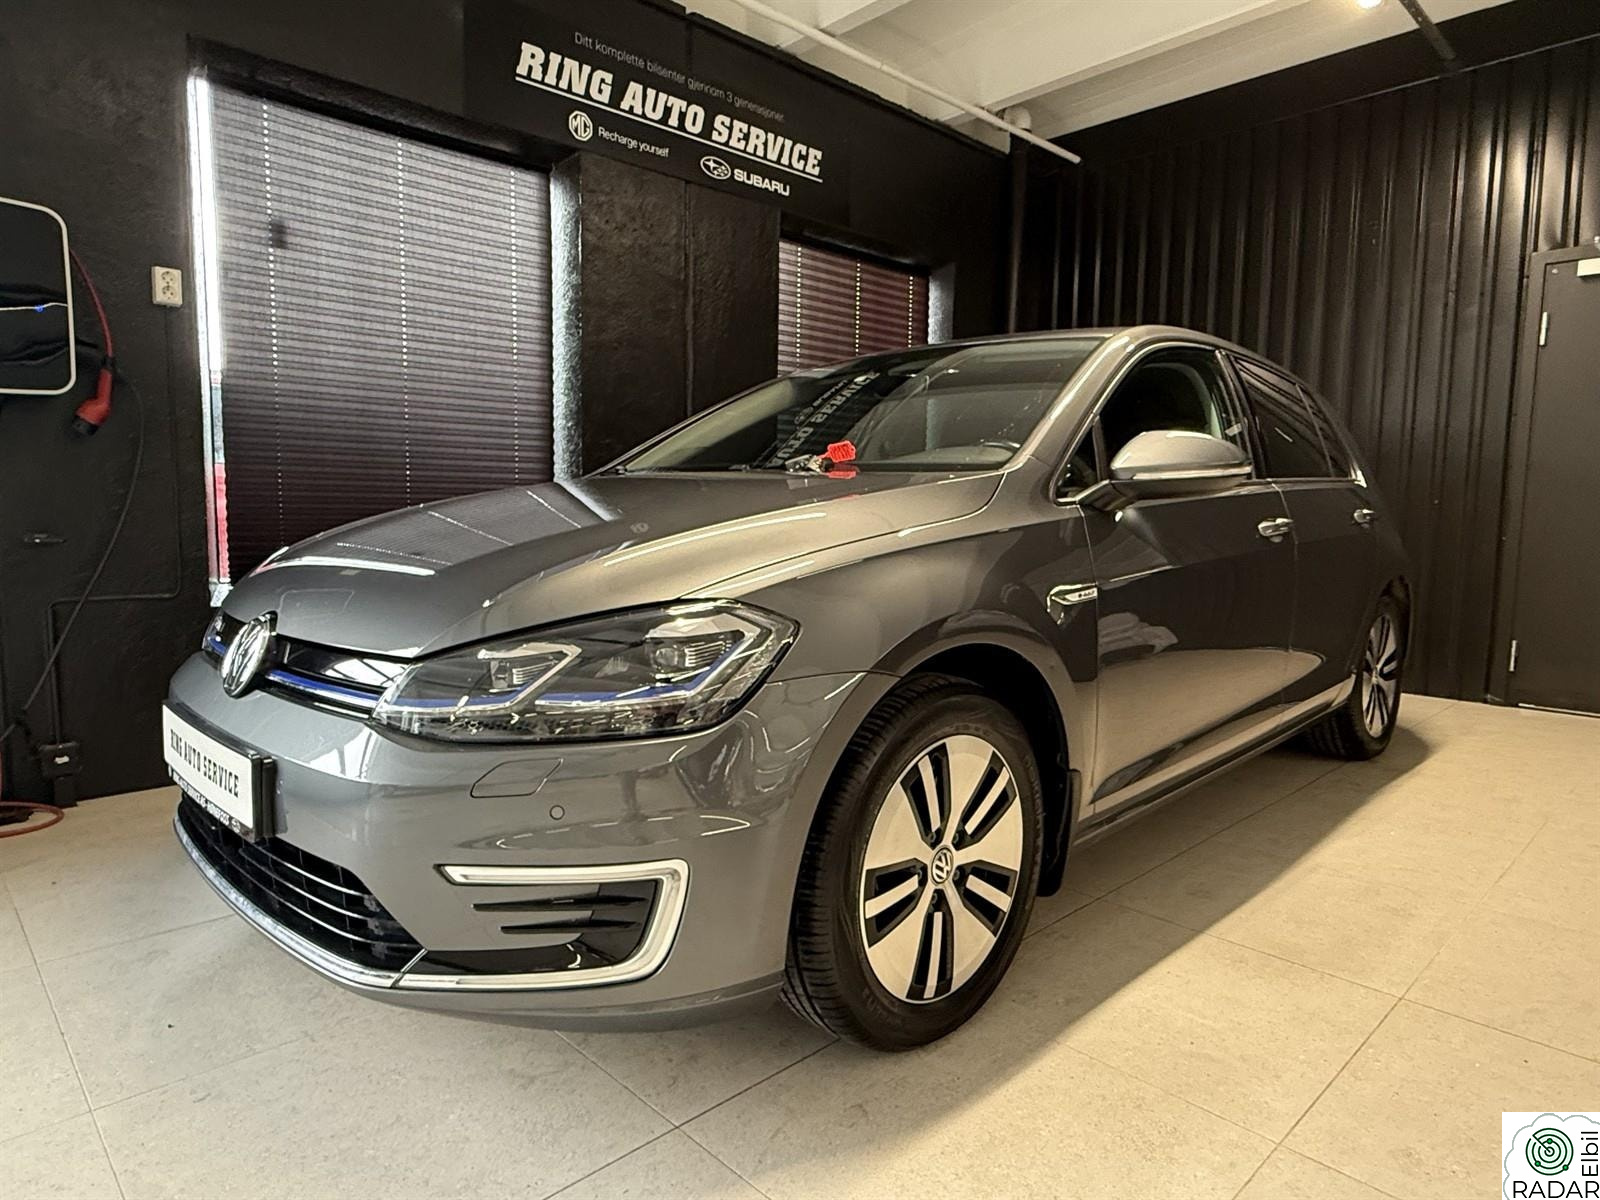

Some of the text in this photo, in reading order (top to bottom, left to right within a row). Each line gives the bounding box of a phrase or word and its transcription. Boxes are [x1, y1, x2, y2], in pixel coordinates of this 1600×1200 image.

[575, 32, 593, 49] Ditt
[595, 39, 645, 69] komplette
[726, 91, 733, 103] 3
[516, 42, 823, 176] RING AUTO SERVICE
[598, 126, 669, 158] Recharge yourself
[733, 168, 790, 196] SUBARU
[184, 741, 201, 772] AUTO
[203, 755, 239, 798] SERVICE
